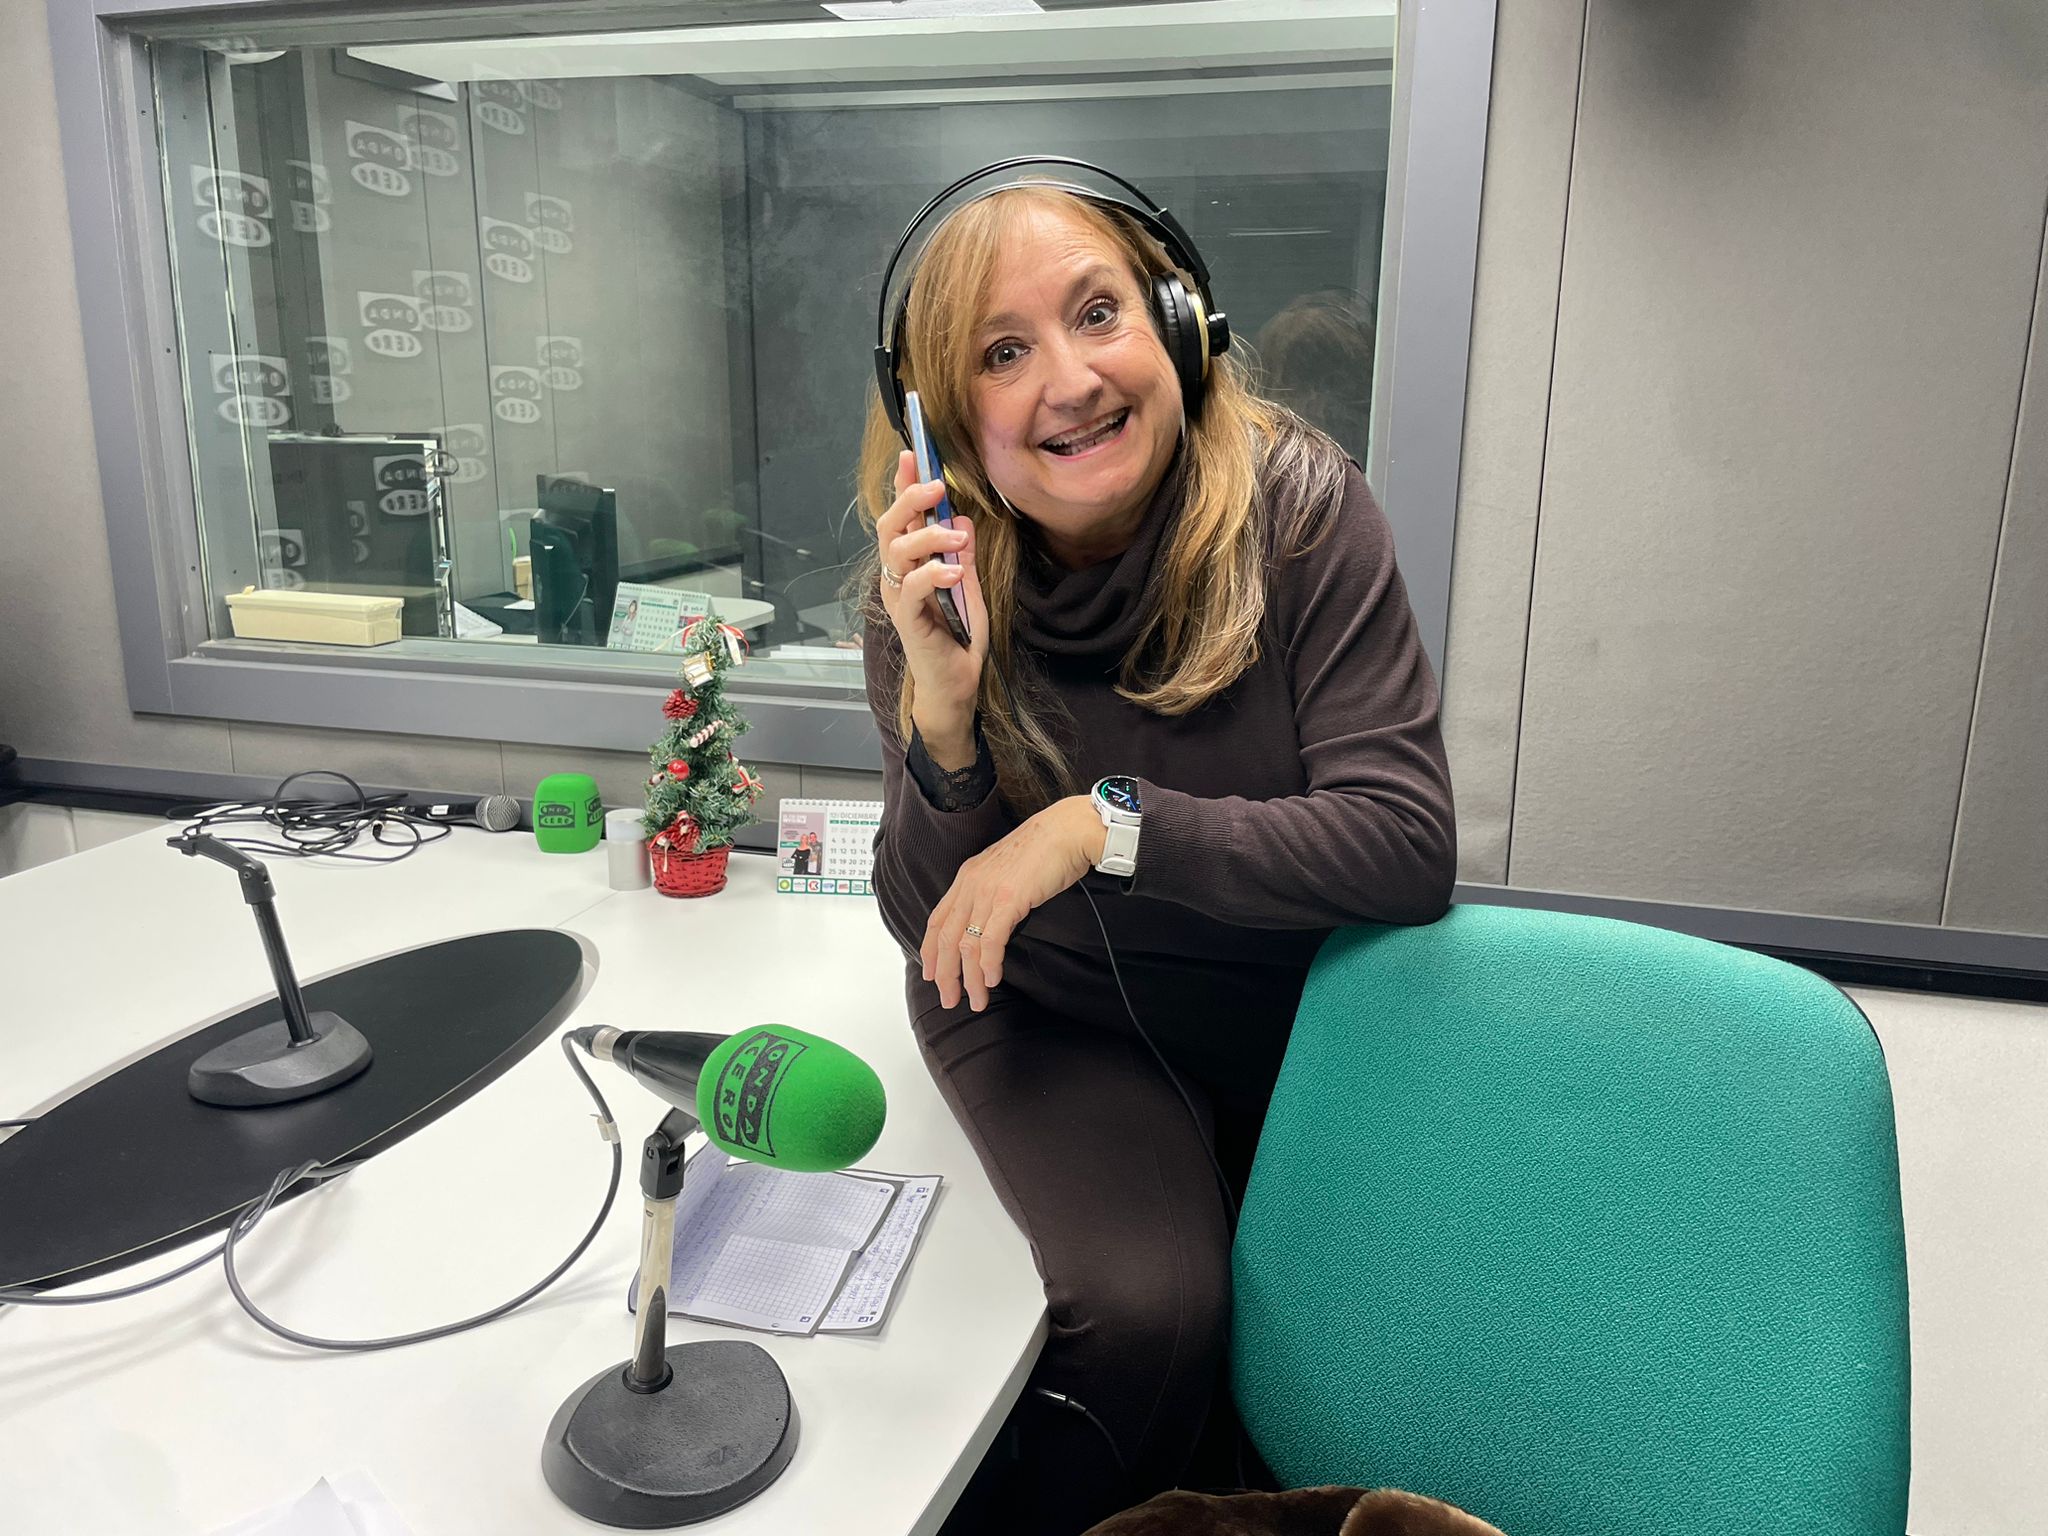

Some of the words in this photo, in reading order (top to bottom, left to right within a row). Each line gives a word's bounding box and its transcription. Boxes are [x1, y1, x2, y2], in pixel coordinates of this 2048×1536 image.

[840, 812, 879, 820] DICIEMBRE
[722, 1046, 760, 1129] CERO
[744, 1049, 784, 1134] ONDA
